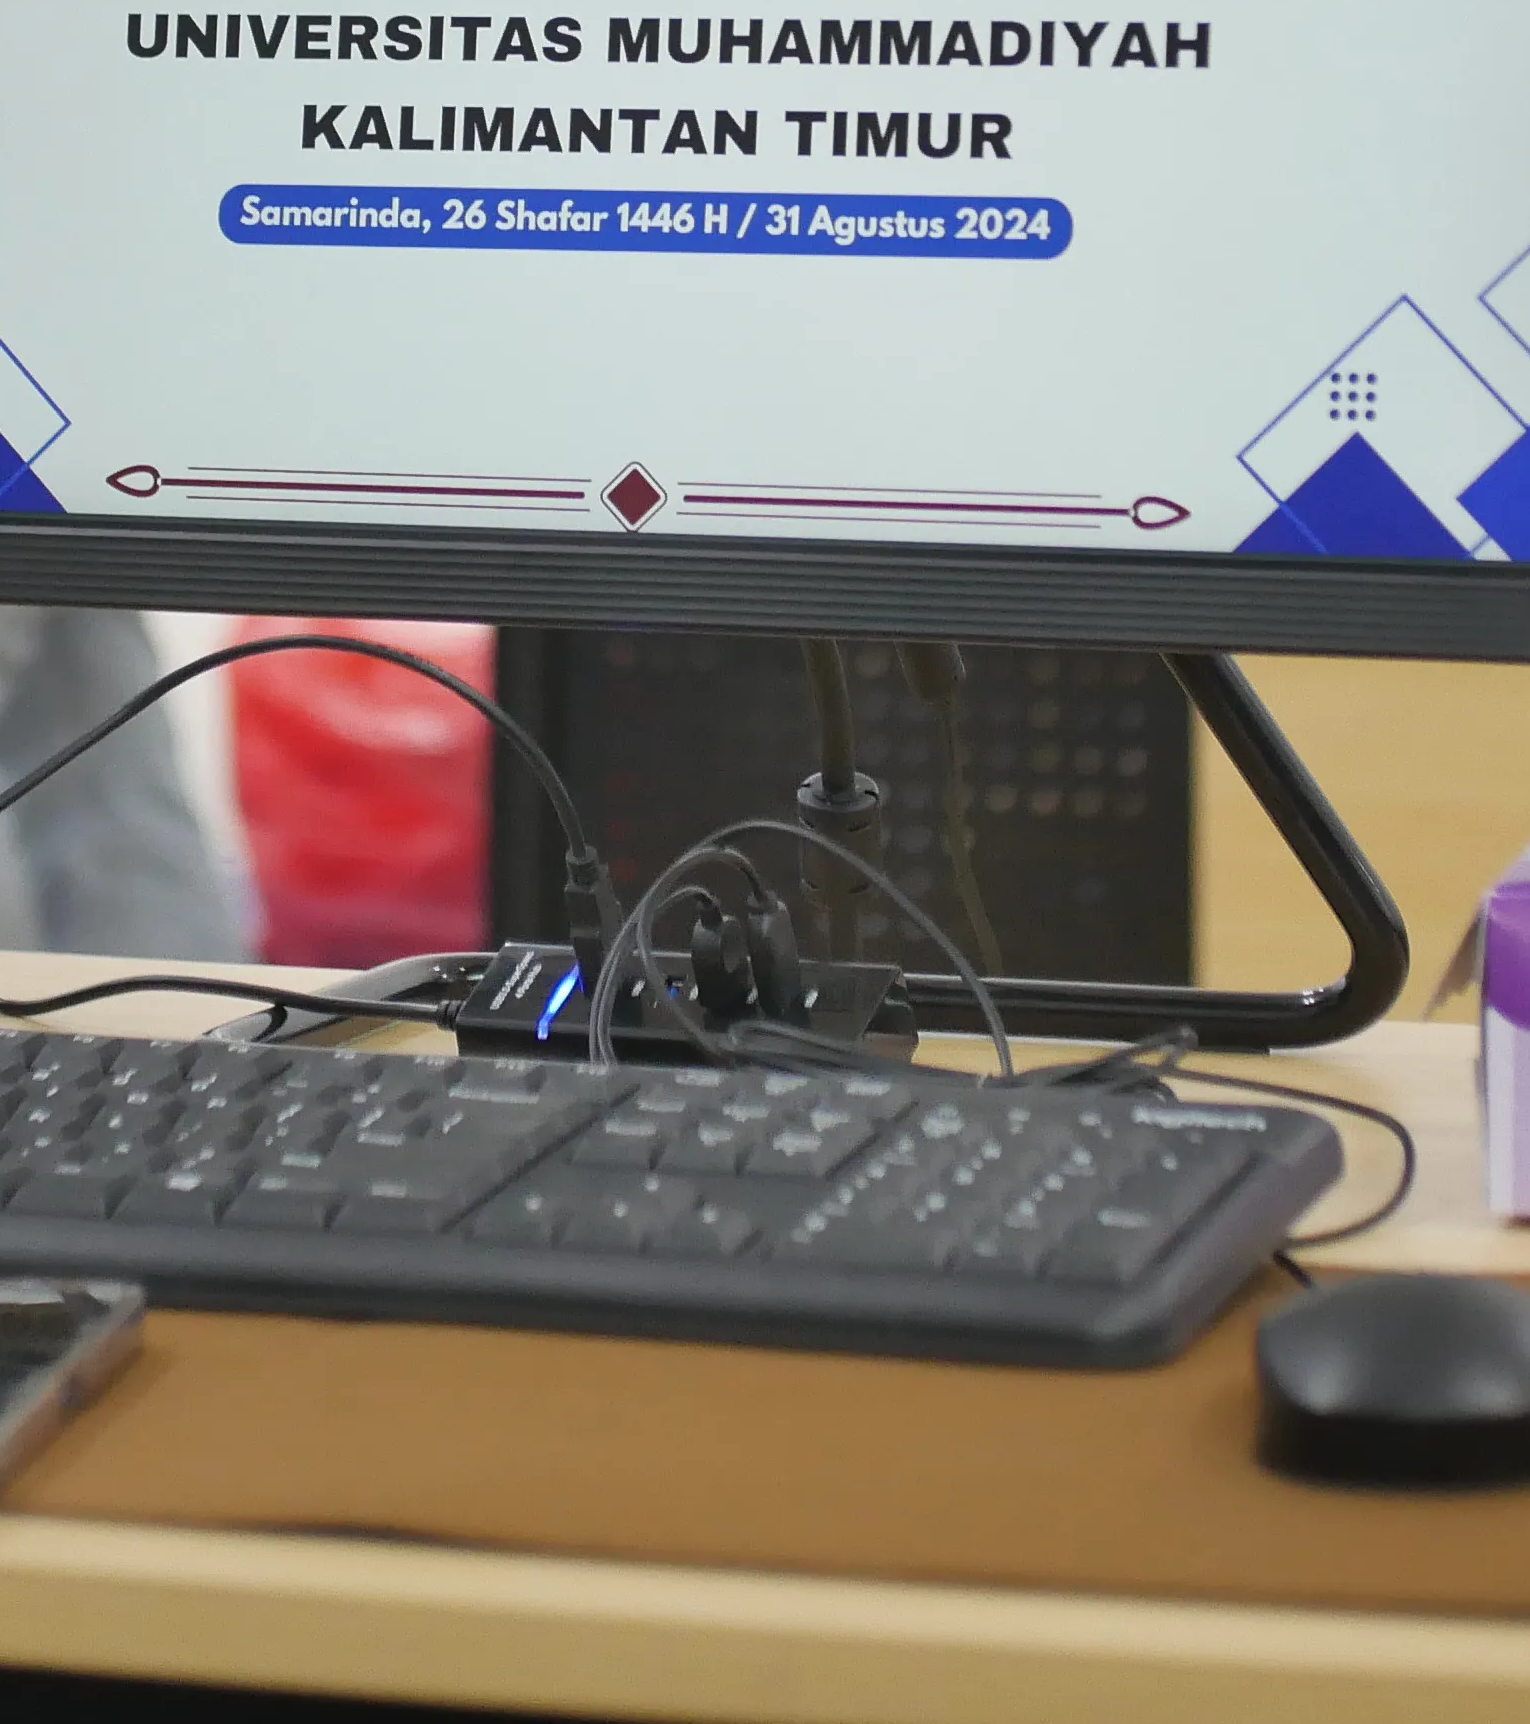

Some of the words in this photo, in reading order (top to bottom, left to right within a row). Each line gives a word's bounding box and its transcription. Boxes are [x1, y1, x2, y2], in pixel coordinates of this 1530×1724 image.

[127, 13, 582, 63] UNIVERSITAS
[607, 17, 1210, 68] MUHAMMADIYAH
[301, 104, 758, 156] KALIMANTAN
[784, 110, 1012, 160] TIMUR
[239, 194, 432, 234] Samarinda,
[441, 198, 487, 231] 26
[495, 198, 609, 233] Shafar
[616, 202, 696, 234] 1446
[703, 204, 729, 234] H
[736, 203, 758, 239] /
[765, 205, 801, 236] 31
[807, 205, 946, 246] Agustus
[953, 208, 1051, 241] 2024
